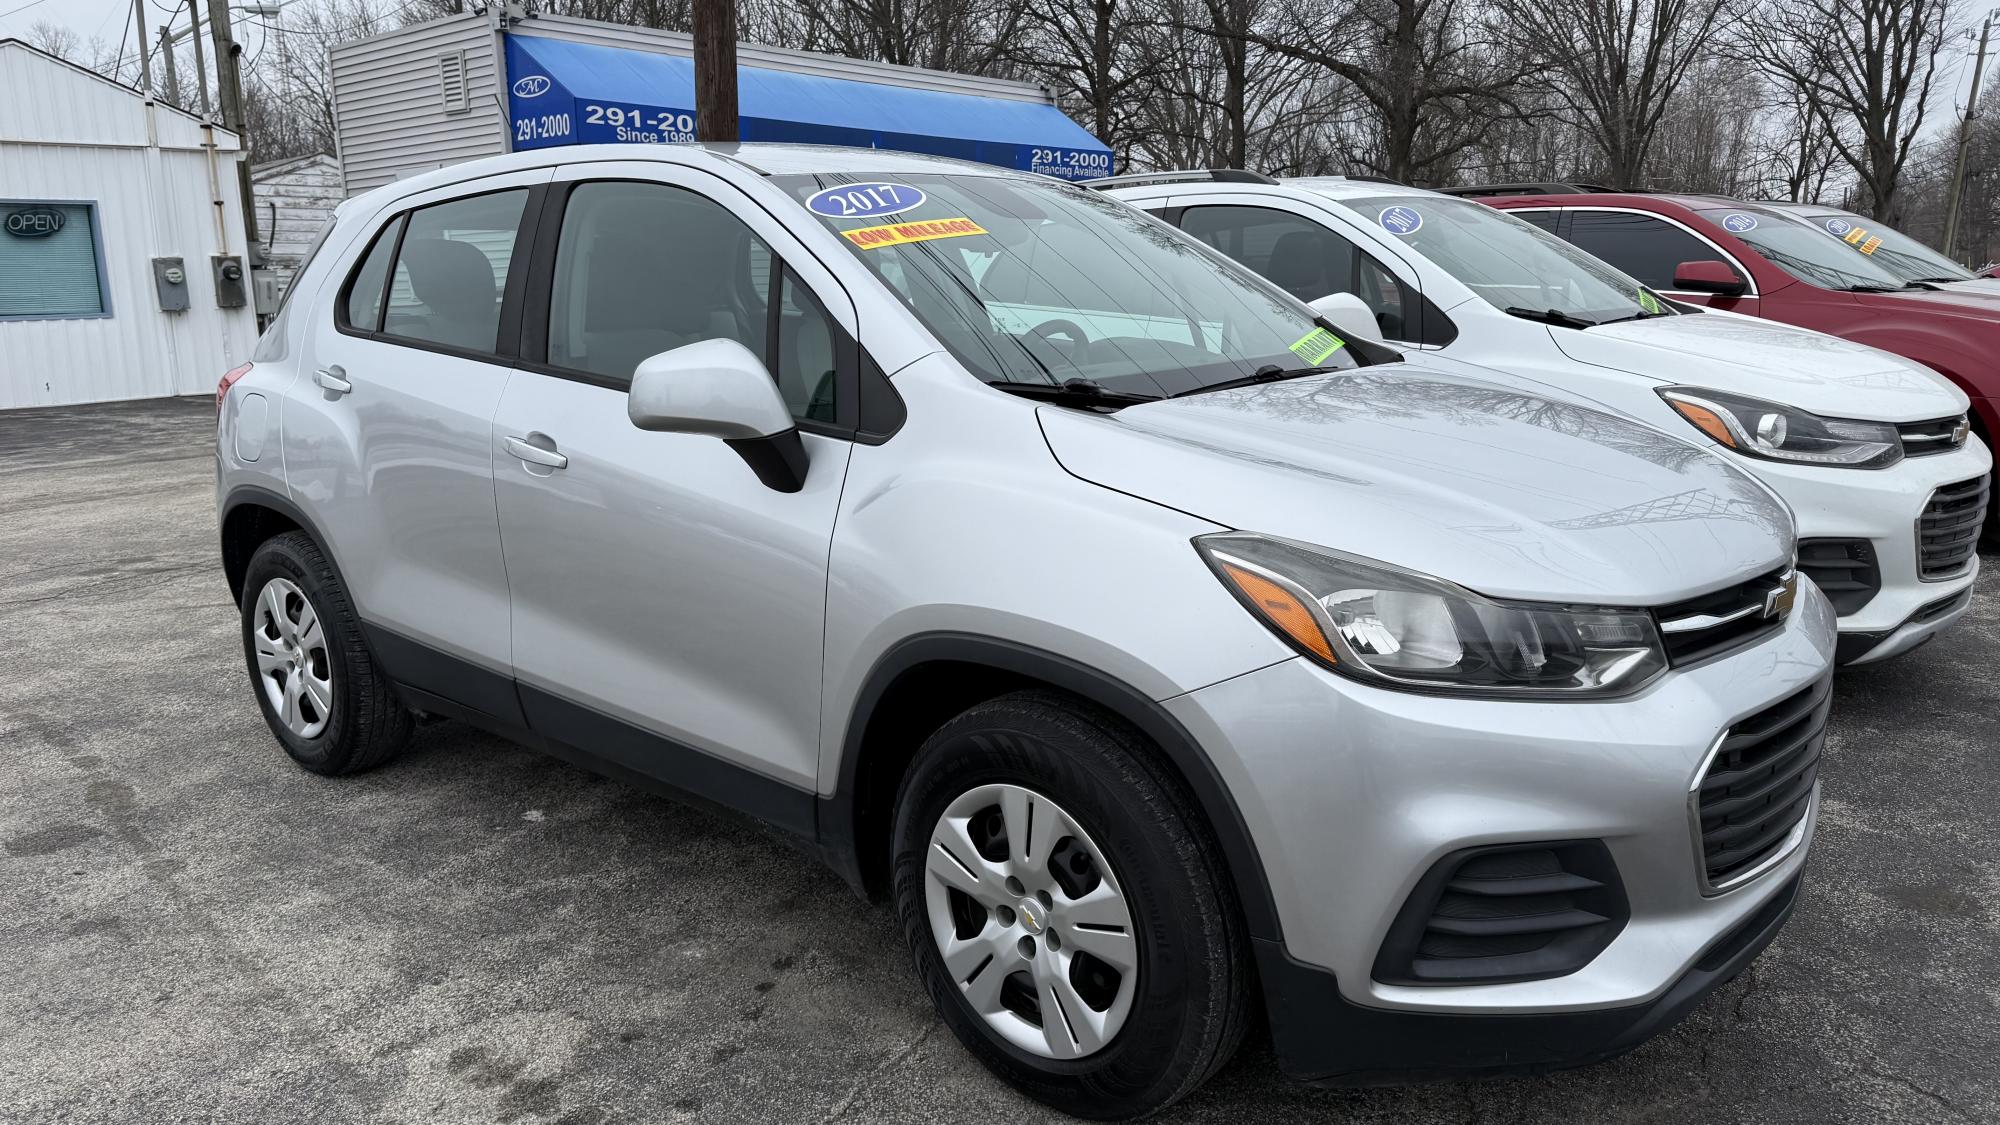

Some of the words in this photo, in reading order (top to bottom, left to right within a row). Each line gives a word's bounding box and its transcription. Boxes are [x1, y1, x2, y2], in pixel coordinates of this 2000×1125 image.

[517, 113, 570, 141] 291-2000
[617, 127, 658, 143] Since
[663, 131, 695, 143] 1989
[1032, 149, 1109, 168] 291-2000
[1032, 163, 1073, 178] Financing
[1074, 165, 1109, 177] Available
[829, 186, 900, 215] 2017
[8, 214, 59, 230] OPEN
[1386, 207, 1415, 232] 2017
[848, 228, 897, 246] LOW
[895, 220, 982, 240] MILEAGE
